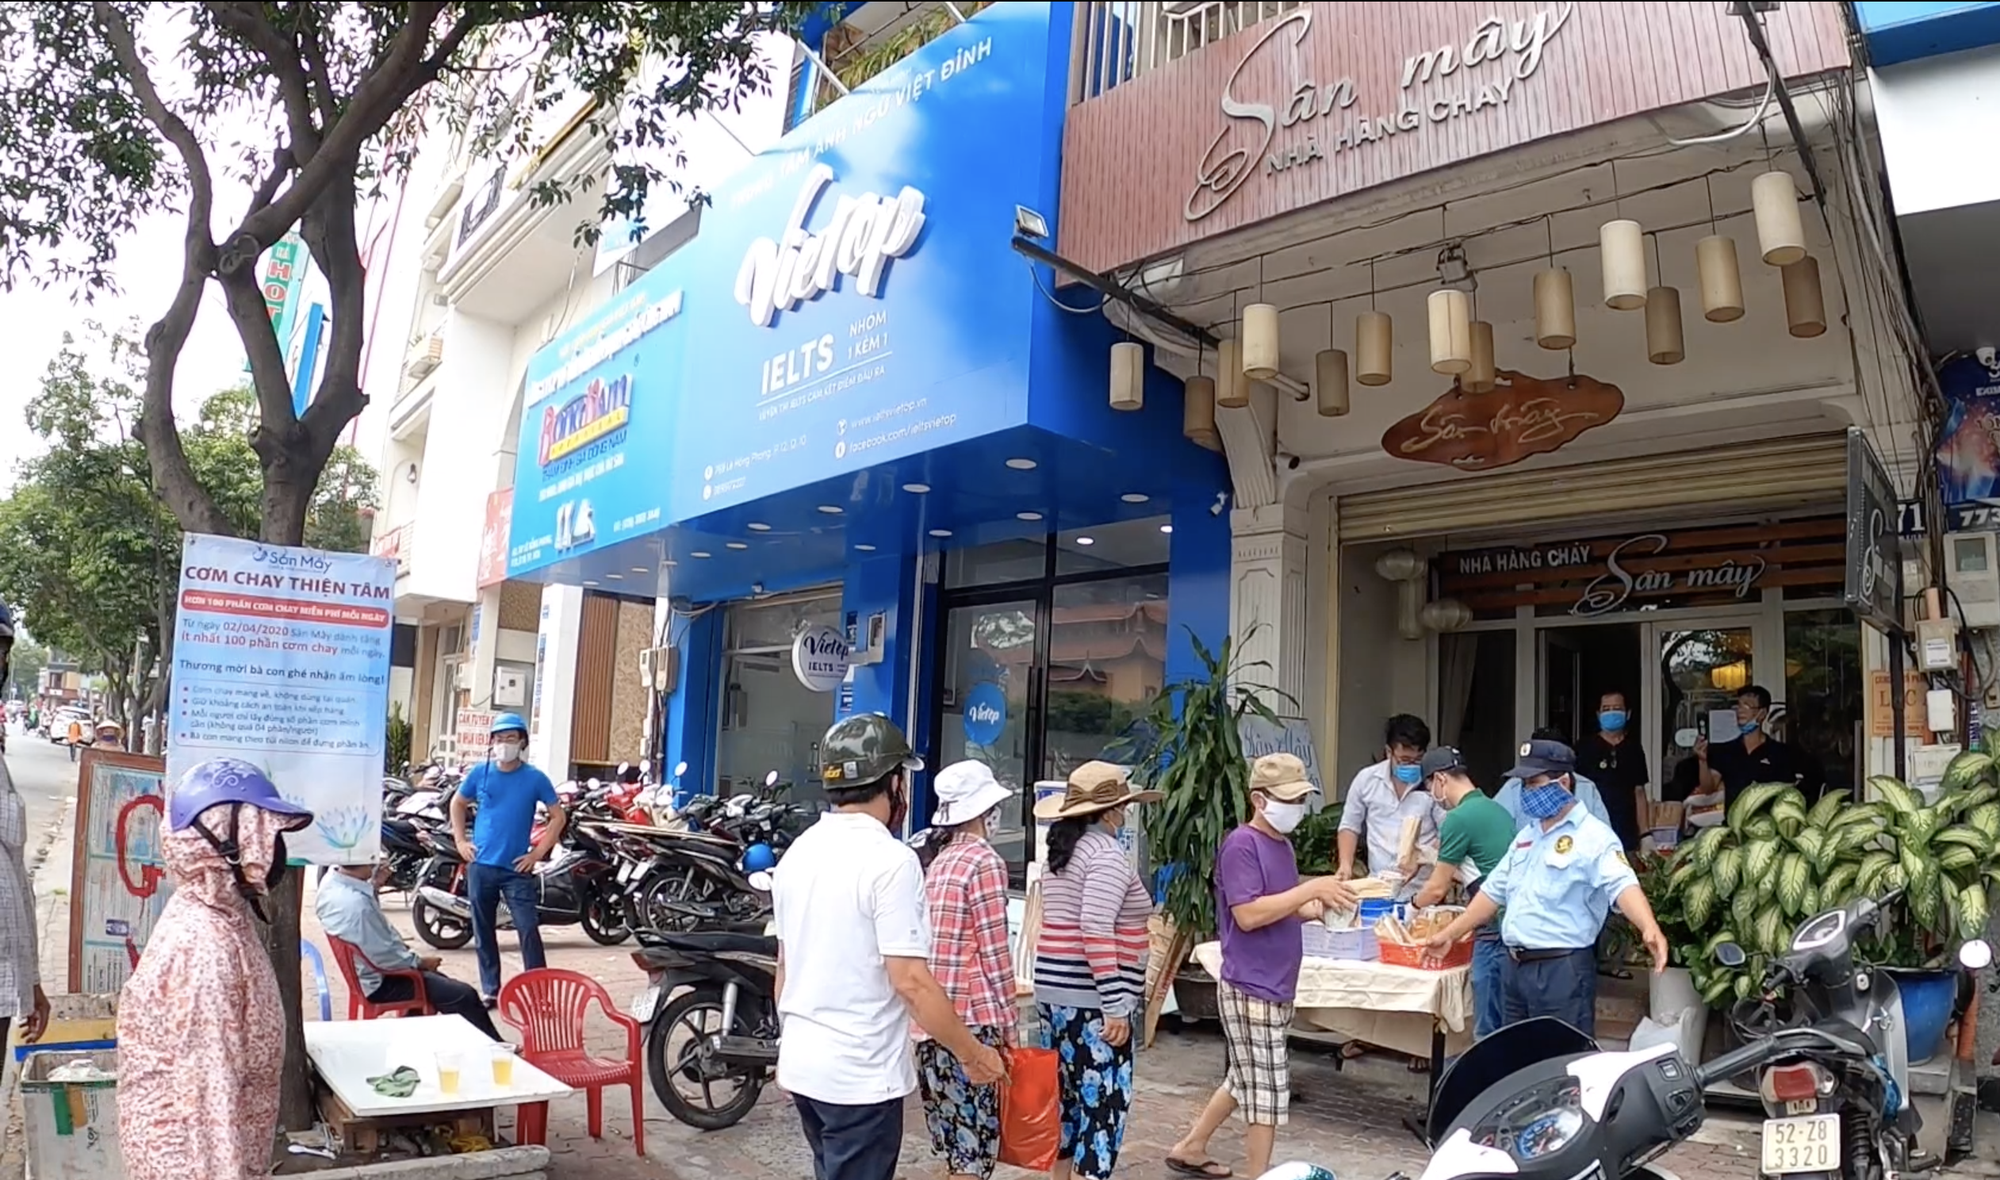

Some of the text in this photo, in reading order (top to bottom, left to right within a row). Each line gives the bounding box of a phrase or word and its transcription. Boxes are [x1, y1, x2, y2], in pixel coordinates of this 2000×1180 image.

[895, 69, 935, 107] VIỆT
[1265, 77, 1515, 176] NHÀ HÀNG CHAY
[733, 162, 927, 326] Vietop
[849, 309, 887, 338] NHÓM
[761, 333, 834, 395] IELTS
[1496, 549, 1542, 573] HÀNG
[185, 566, 390, 599] CƠM CHAY THIỆN TÂM
[274, 604, 299, 614] CHAY
[223, 621, 289, 637] 02/04/2020
[193, 631, 220, 644] nhất
[225, 635, 246, 645] 100
[249, 636, 279, 650] phần
[282, 641, 308, 651] cơm
[311, 642, 338, 656] chay
[266, 667, 285, 676] con
[288, 668, 307, 679] ghé
[309, 670, 336, 681] nhận
[808, 661, 834, 672] IELTS
[1775, 1120, 1827, 1145] 52-Z8
[1774, 1144, 1828, 1169] 3320
